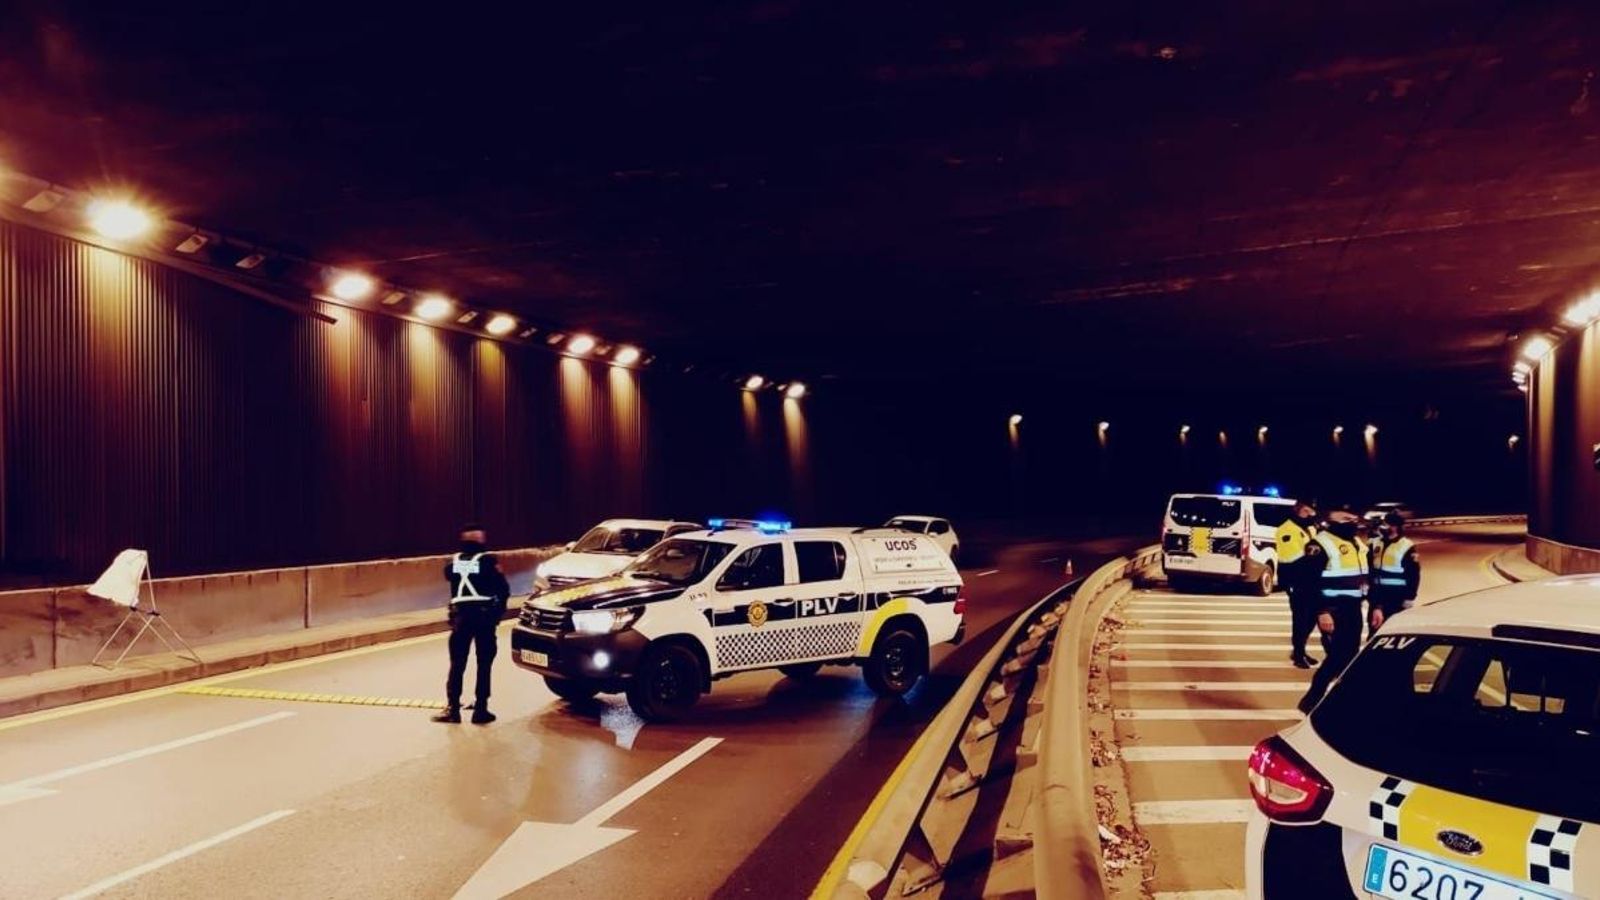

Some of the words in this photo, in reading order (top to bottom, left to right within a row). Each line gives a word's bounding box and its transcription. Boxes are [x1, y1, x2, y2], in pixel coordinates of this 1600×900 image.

[885, 540, 918, 552] UCOS
[801, 598, 838, 616] PLV
[1372, 636, 1416, 650] PLV
[1372, 873, 1379, 884] E
[1389, 859, 1485, 900] 6207
